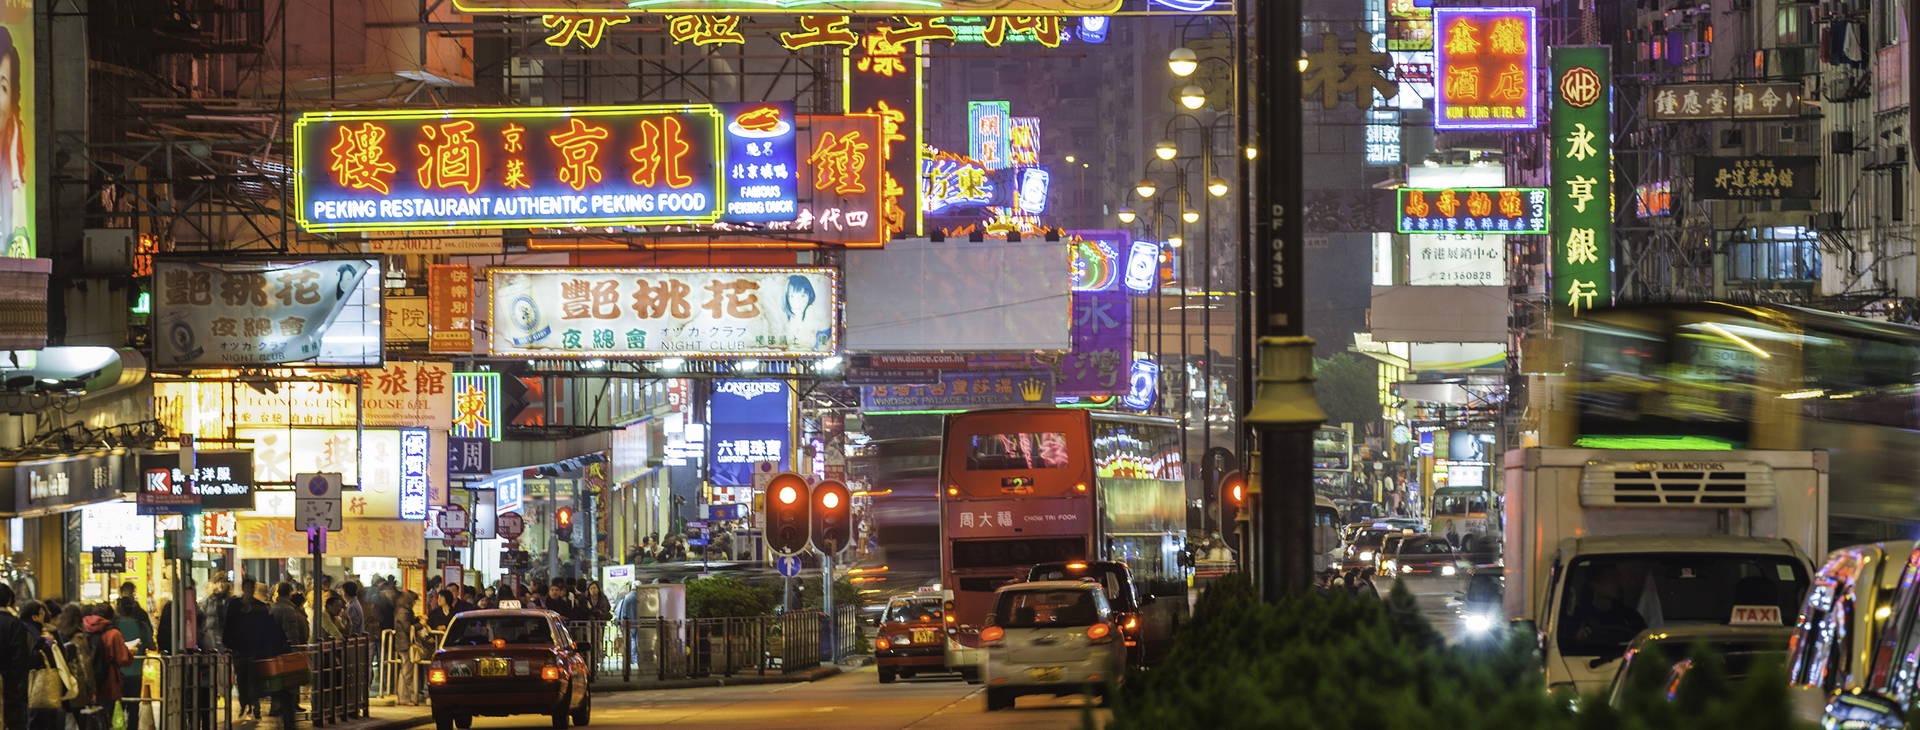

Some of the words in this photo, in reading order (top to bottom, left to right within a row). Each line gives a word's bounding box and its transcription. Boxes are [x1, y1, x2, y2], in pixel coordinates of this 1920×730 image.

[1447, 64, 1526, 100] 酒店
[502, 123, 530, 189] 京菜
[1367, 144, 1400, 163] 酒店
[740, 185, 781, 198] FAMOUS
[314, 201, 377, 219] PEKING
[380, 199, 490, 218] RESTAURANT
[493, 196, 588, 215] AUTHENTIC
[592, 194, 656, 214] PEKING
[658, 193, 706, 212] FOOD
[728, 202, 765, 214] PEKING
[766, 200, 793, 213] DUCK
[1272, 204, 1284, 230] DF
[1566, 123, 1598, 317] 永亨銀行
[1272, 239, 1284, 288] 0433
[562, 328, 648, 350] 夜總會
[661, 340, 703, 350] NIGHT
[710, 340, 745, 350] CLUB
[221, 354, 253, 362] NIGHT
[717, 382, 782, 393] LONGINES
[305, 399, 350, 408] GUEST
[717, 440, 782, 456] 六福珠寶
[1662, 462, 1681, 470] KIA
[1683, 461, 1725, 470] MOTORS
[201, 484, 221, 495] Kee
[222, 484, 249, 494] Tailor
[960, 511, 1013, 528] 周大福
[1735, 608, 1778, 622] TAXI
